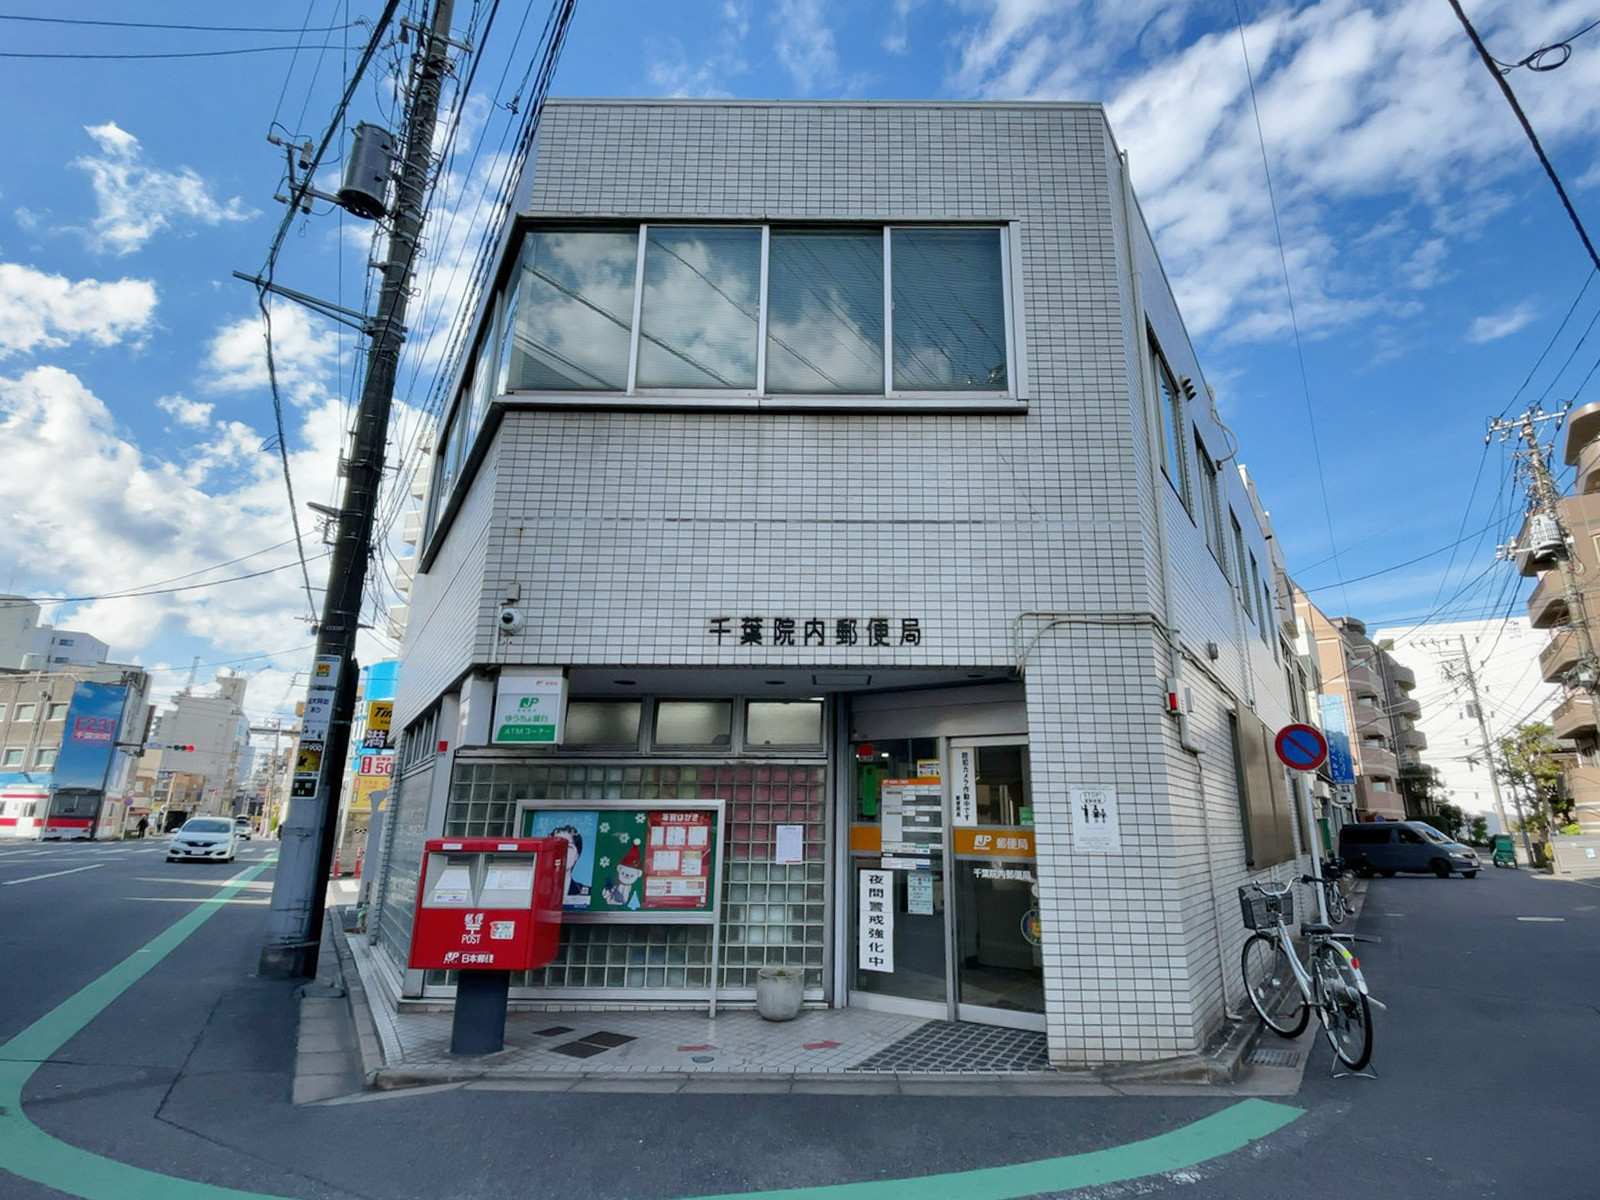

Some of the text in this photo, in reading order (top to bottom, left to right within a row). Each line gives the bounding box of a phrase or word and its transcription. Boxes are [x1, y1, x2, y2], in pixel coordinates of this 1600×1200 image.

[709, 617, 921, 647] 千葉院内郵便局
[505, 715, 548, 723] ゆうちょ銀行
[364, 730, 386, 748] 満
[996, 837, 1029, 850] 郵便局
[464, 913, 484, 925] 郵便
[868, 874, 884, 967] 夜間警戒強化中
[461, 934, 481, 944] POST
[461, 953, 494, 963] 日本郵便
